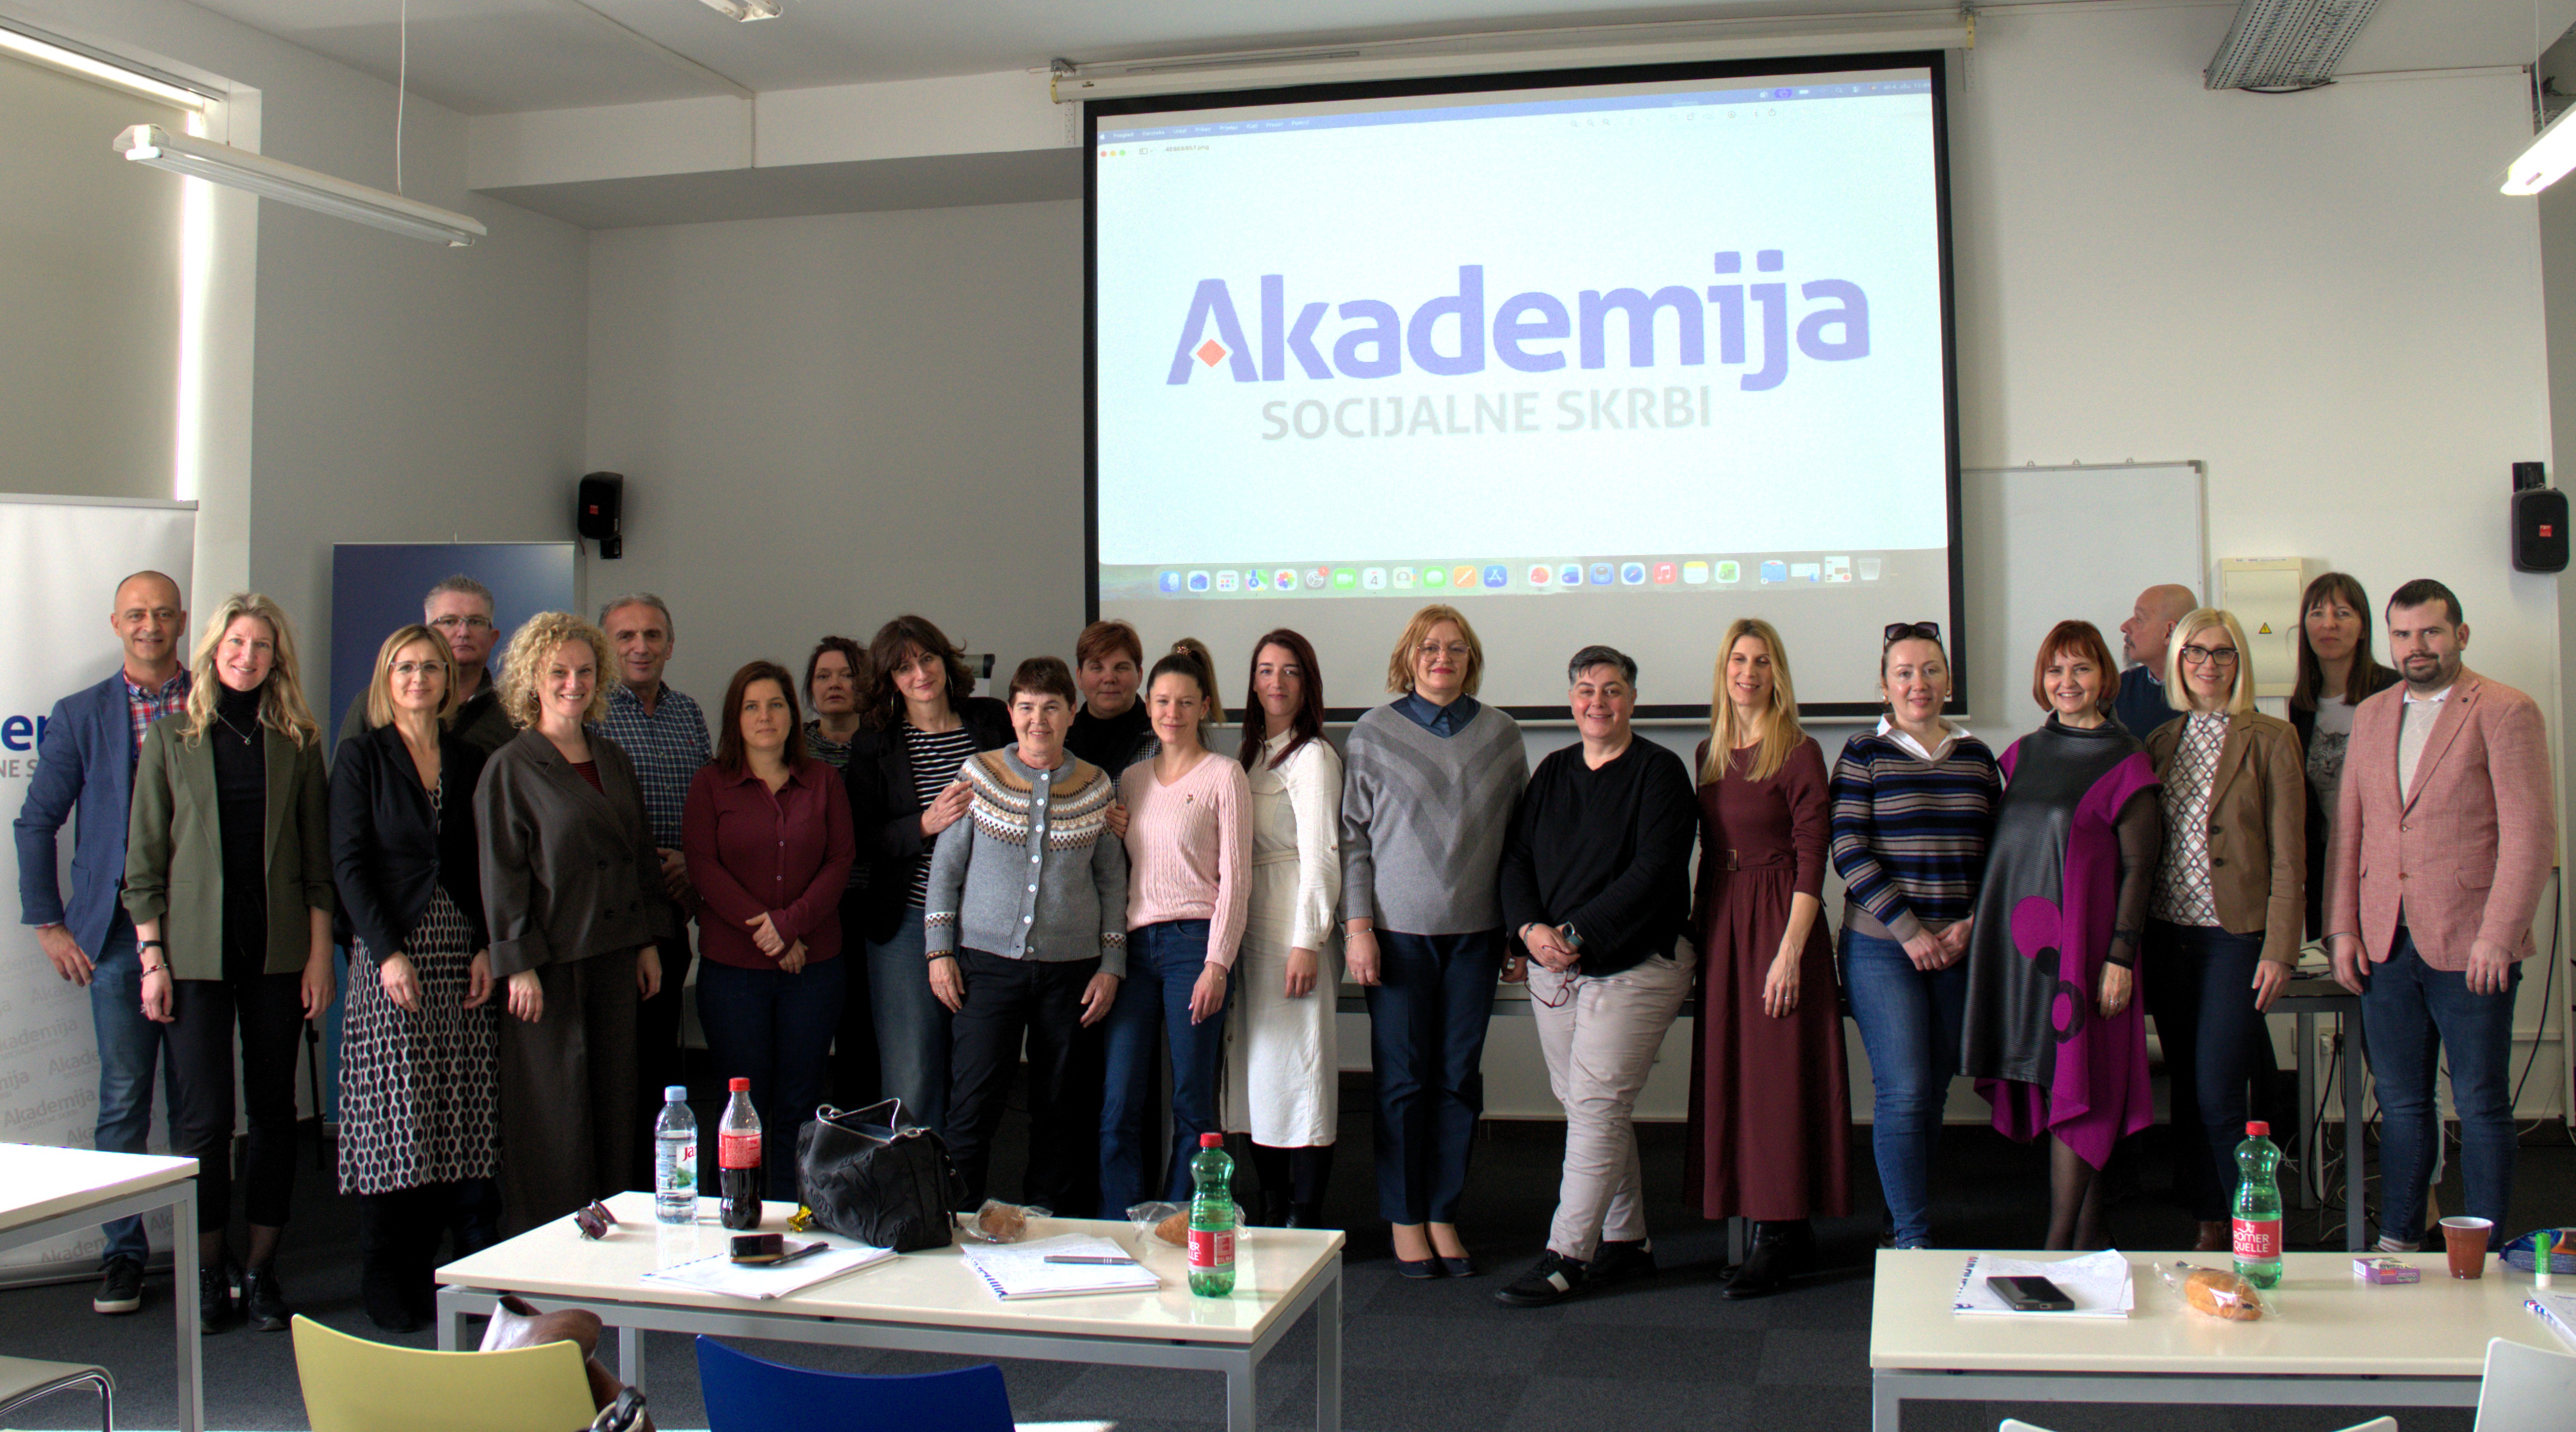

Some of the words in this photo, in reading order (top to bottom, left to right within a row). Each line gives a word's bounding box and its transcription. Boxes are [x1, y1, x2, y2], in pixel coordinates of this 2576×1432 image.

[1165, 249, 1871, 392] Akademija
[1261, 392, 1540, 441] SOCIJALNE
[1555, 384, 1712, 431] SKRBI
[1370, 575, 1378, 585] 4
[4, 1088, 96, 1128] Akademija
